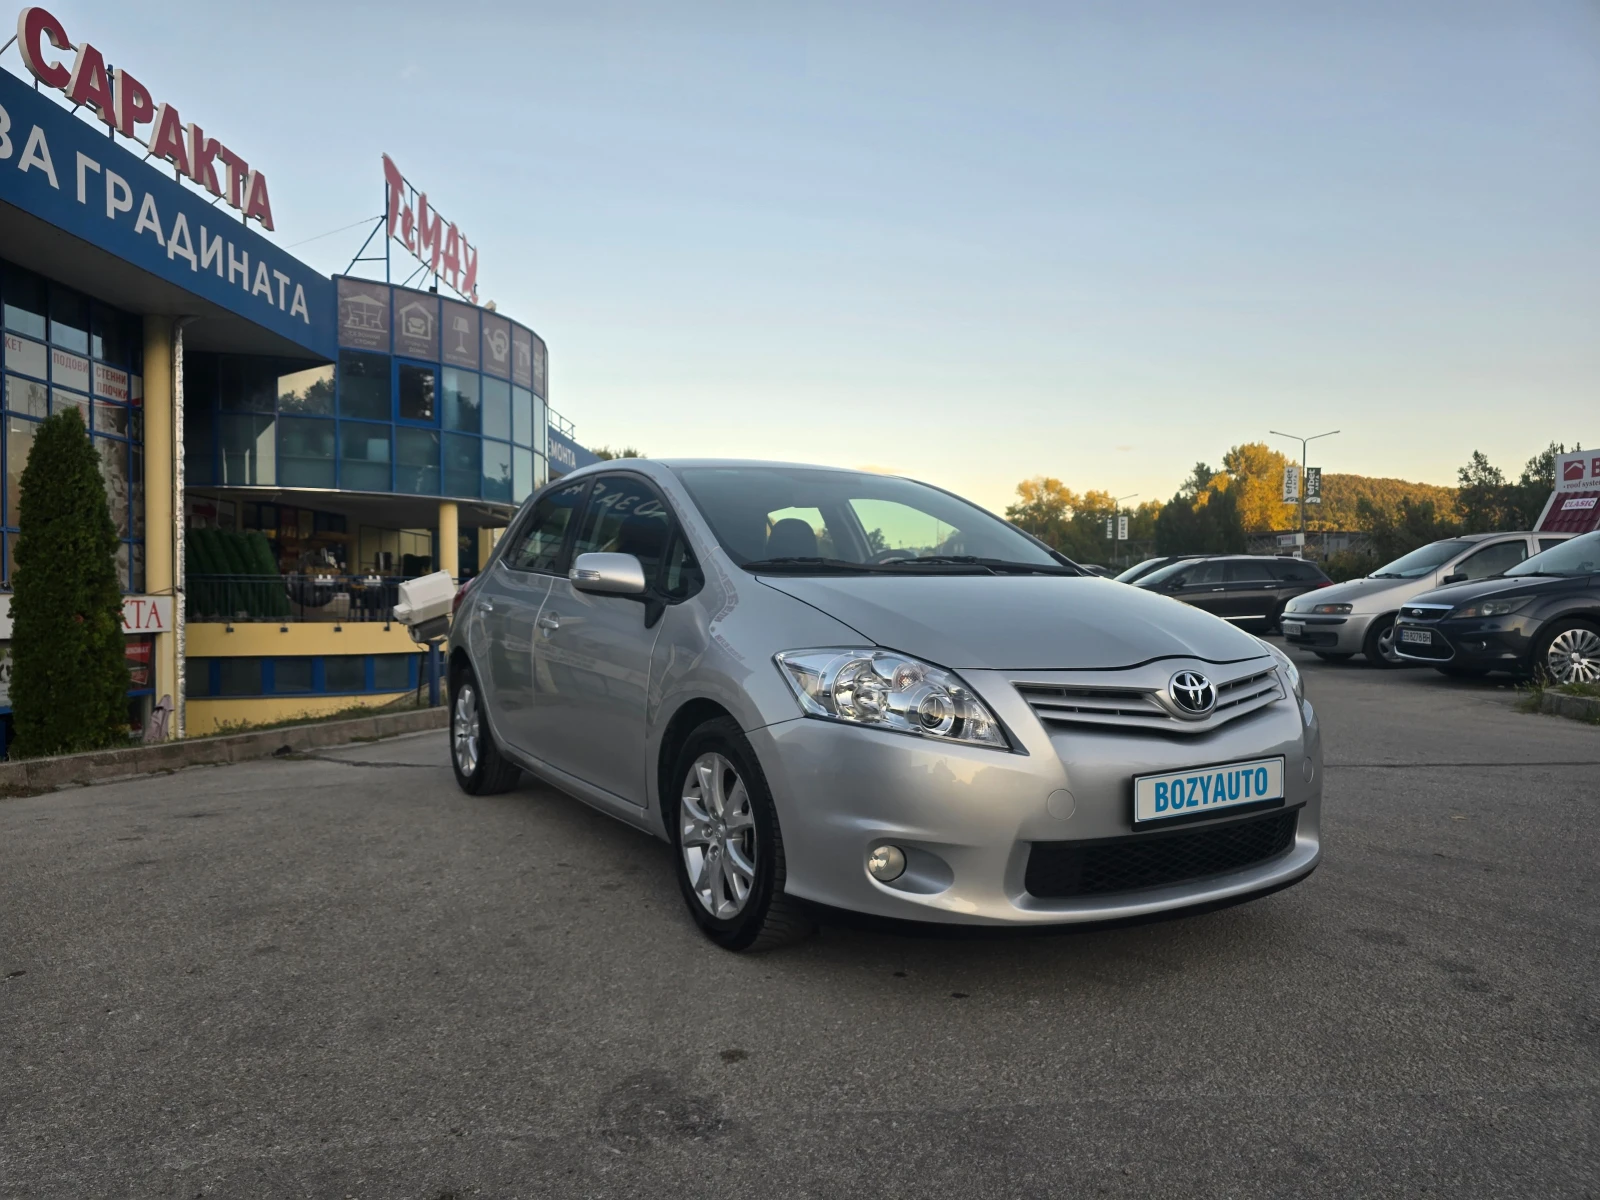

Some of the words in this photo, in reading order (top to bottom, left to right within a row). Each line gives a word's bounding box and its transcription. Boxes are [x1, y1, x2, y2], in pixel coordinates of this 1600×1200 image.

[17, 7, 275, 232] САРАКТА
[76, 150, 310, 325] ГРАДИНАТА
[53, 352, 89, 374] ПОДОВИ
[95, 366, 126, 386] СТЕННИ
[96, 381, 128, 399] ПЛОЧКИ
[1307, 468, 1315, 496] efbet
[1582, 479, 1600, 488] syste
[1564, 500, 1595, 508] CLASIC
[1155, 766, 1268, 813] BOZYAUTO
